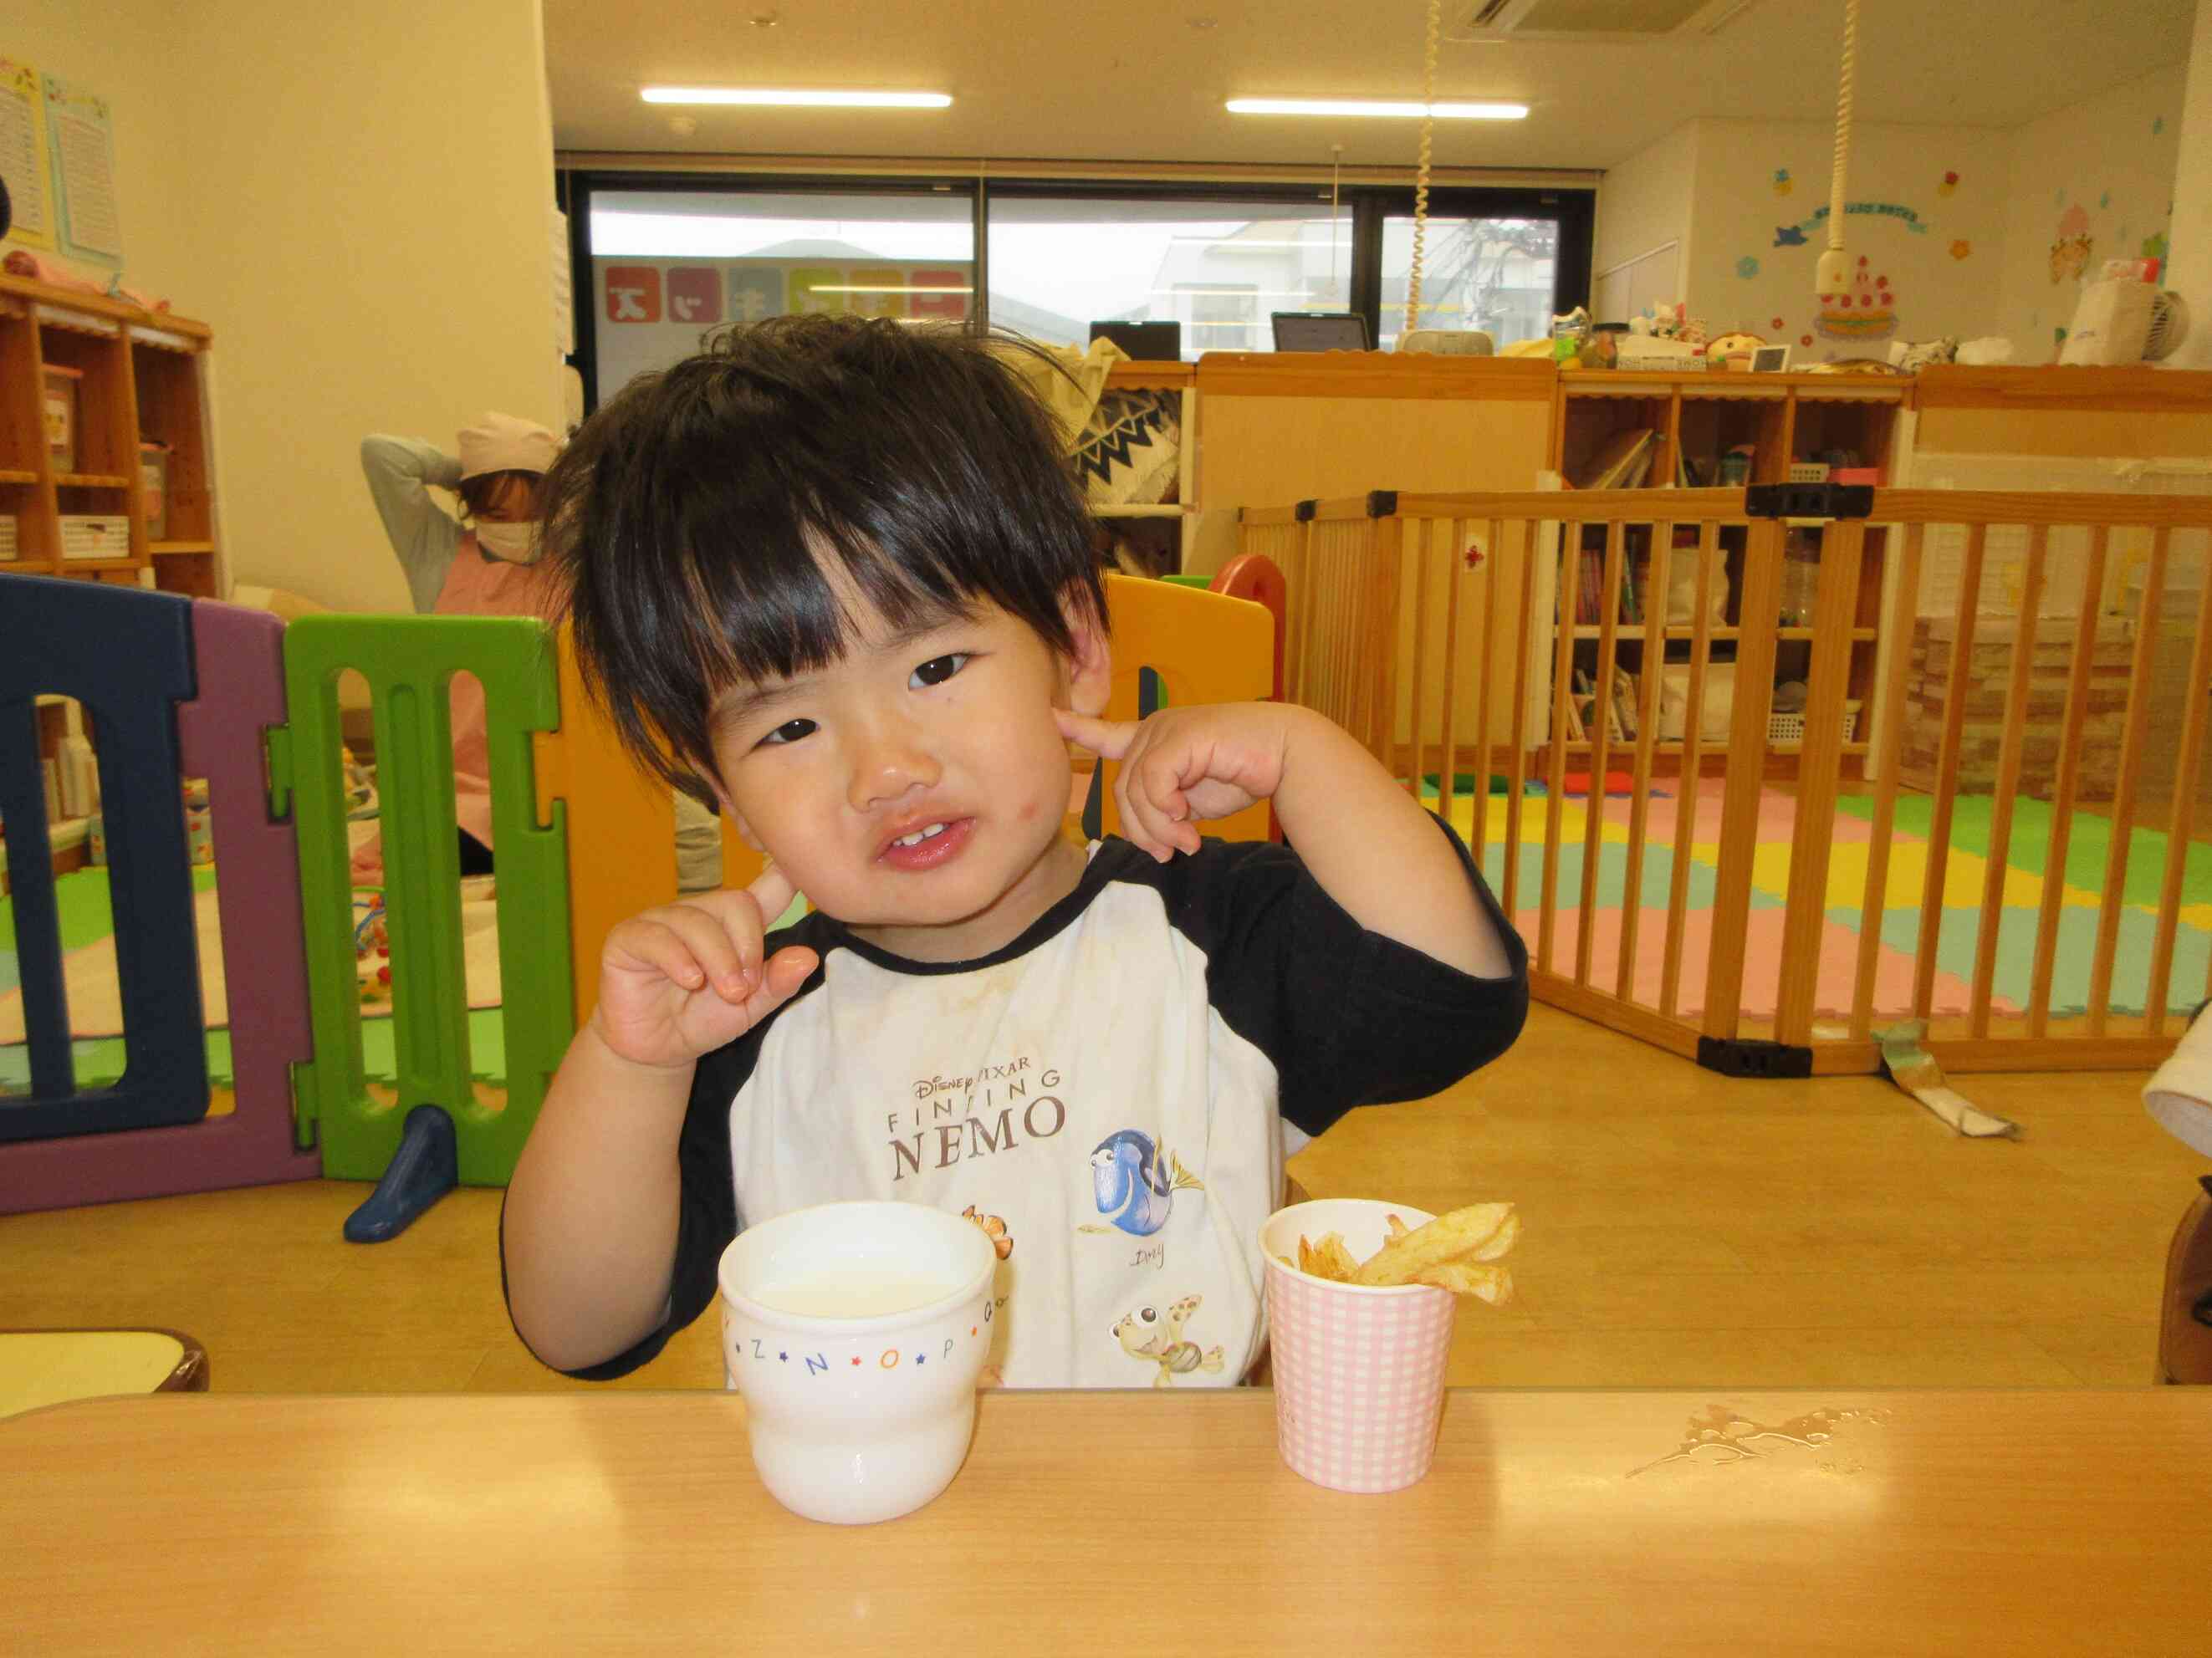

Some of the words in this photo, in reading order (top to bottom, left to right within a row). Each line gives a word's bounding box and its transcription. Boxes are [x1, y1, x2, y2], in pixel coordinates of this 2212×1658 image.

[888, 1095, 1065, 1181] NEMO
[751, 1339, 765, 1360] Z
[805, 1353, 830, 1375] N
[881, 1349, 899, 1370] O
[943, 1339, 954, 1360] P
